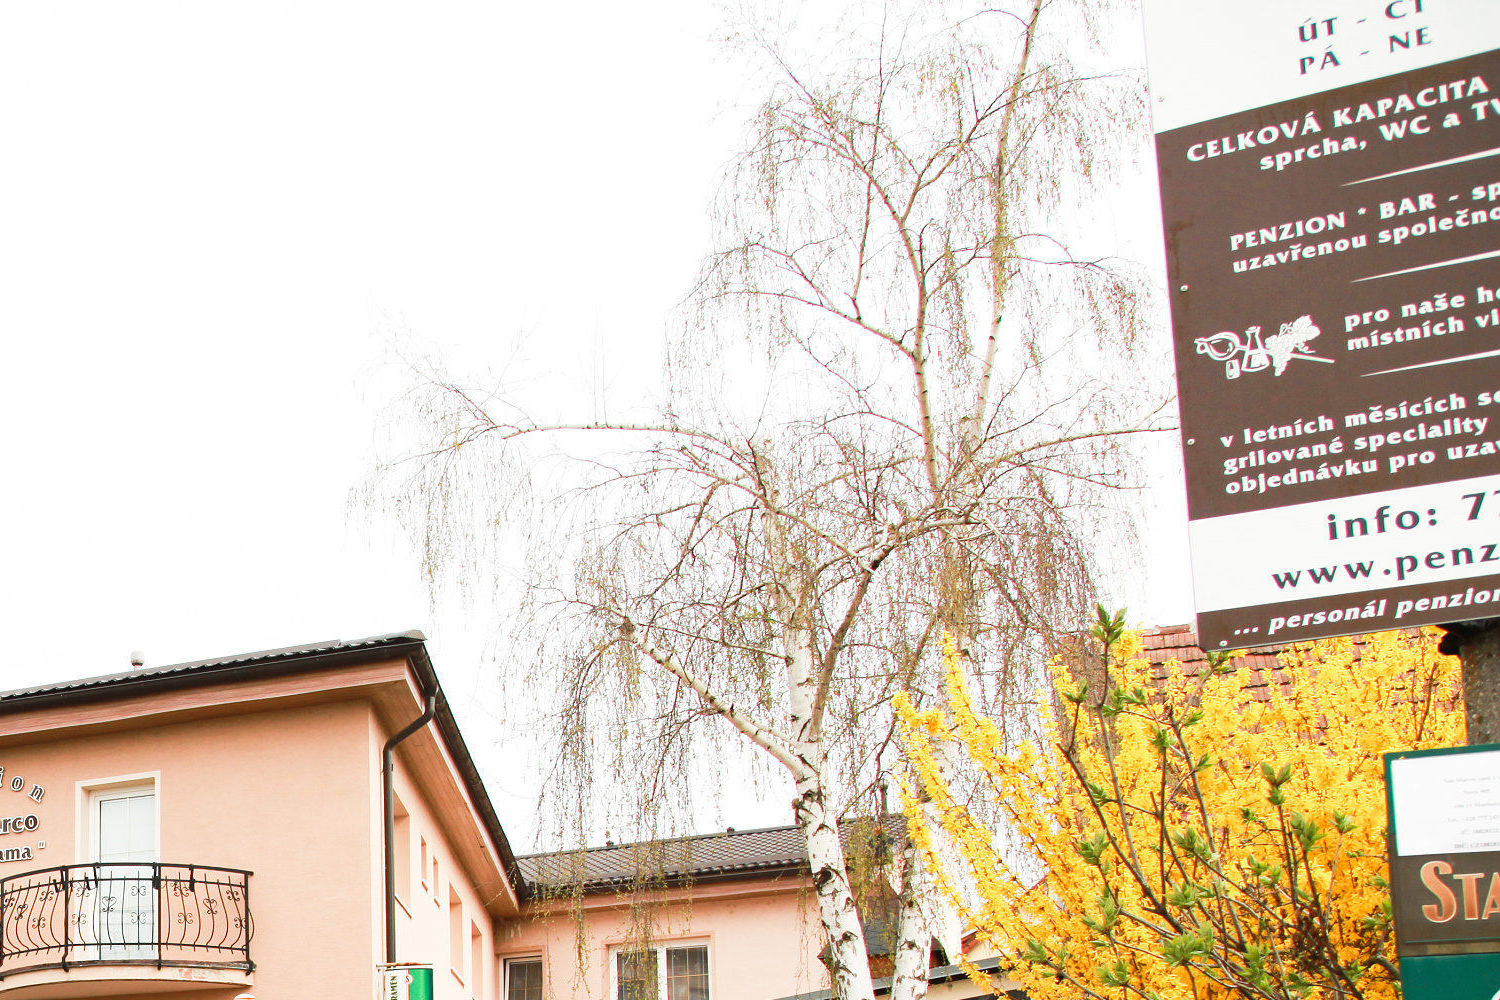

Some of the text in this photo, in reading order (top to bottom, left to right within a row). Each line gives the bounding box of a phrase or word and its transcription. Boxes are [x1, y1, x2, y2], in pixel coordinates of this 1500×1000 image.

[1298, 17, 1338, 43] ÚT
[1299, 45, 1341, 75] PÁ
[1389, 26, 1432, 53] NE
[1186, 76, 1489, 162] CELKOVÁ KAPACITA
[1259, 135, 1367, 172] sprcha,
[1379, 115, 1431, 141] WC
[1443, 112, 1460, 128] a
[1230, 211, 1346, 251] PENZION
[1379, 193, 1437, 219] BAR
[1233, 206, 1500, 273] uzavřenou společno
[1344, 308, 1390, 332] pro
[1401, 292, 1466, 318] naše
[1347, 316, 1465, 351] místních
[1220, 435, 1234, 448] v
[1243, 415, 1334, 445] letních
[1344, 393, 1467, 428] měsících
[1223, 417, 1488, 475] grilované speciality
[1225, 458, 1378, 495] objednávku
[1389, 451, 1436, 474] pro
[1327, 505, 1438, 541] info:
[1272, 543, 1500, 590] www.penz
[1268, 599, 1387, 635] personál
